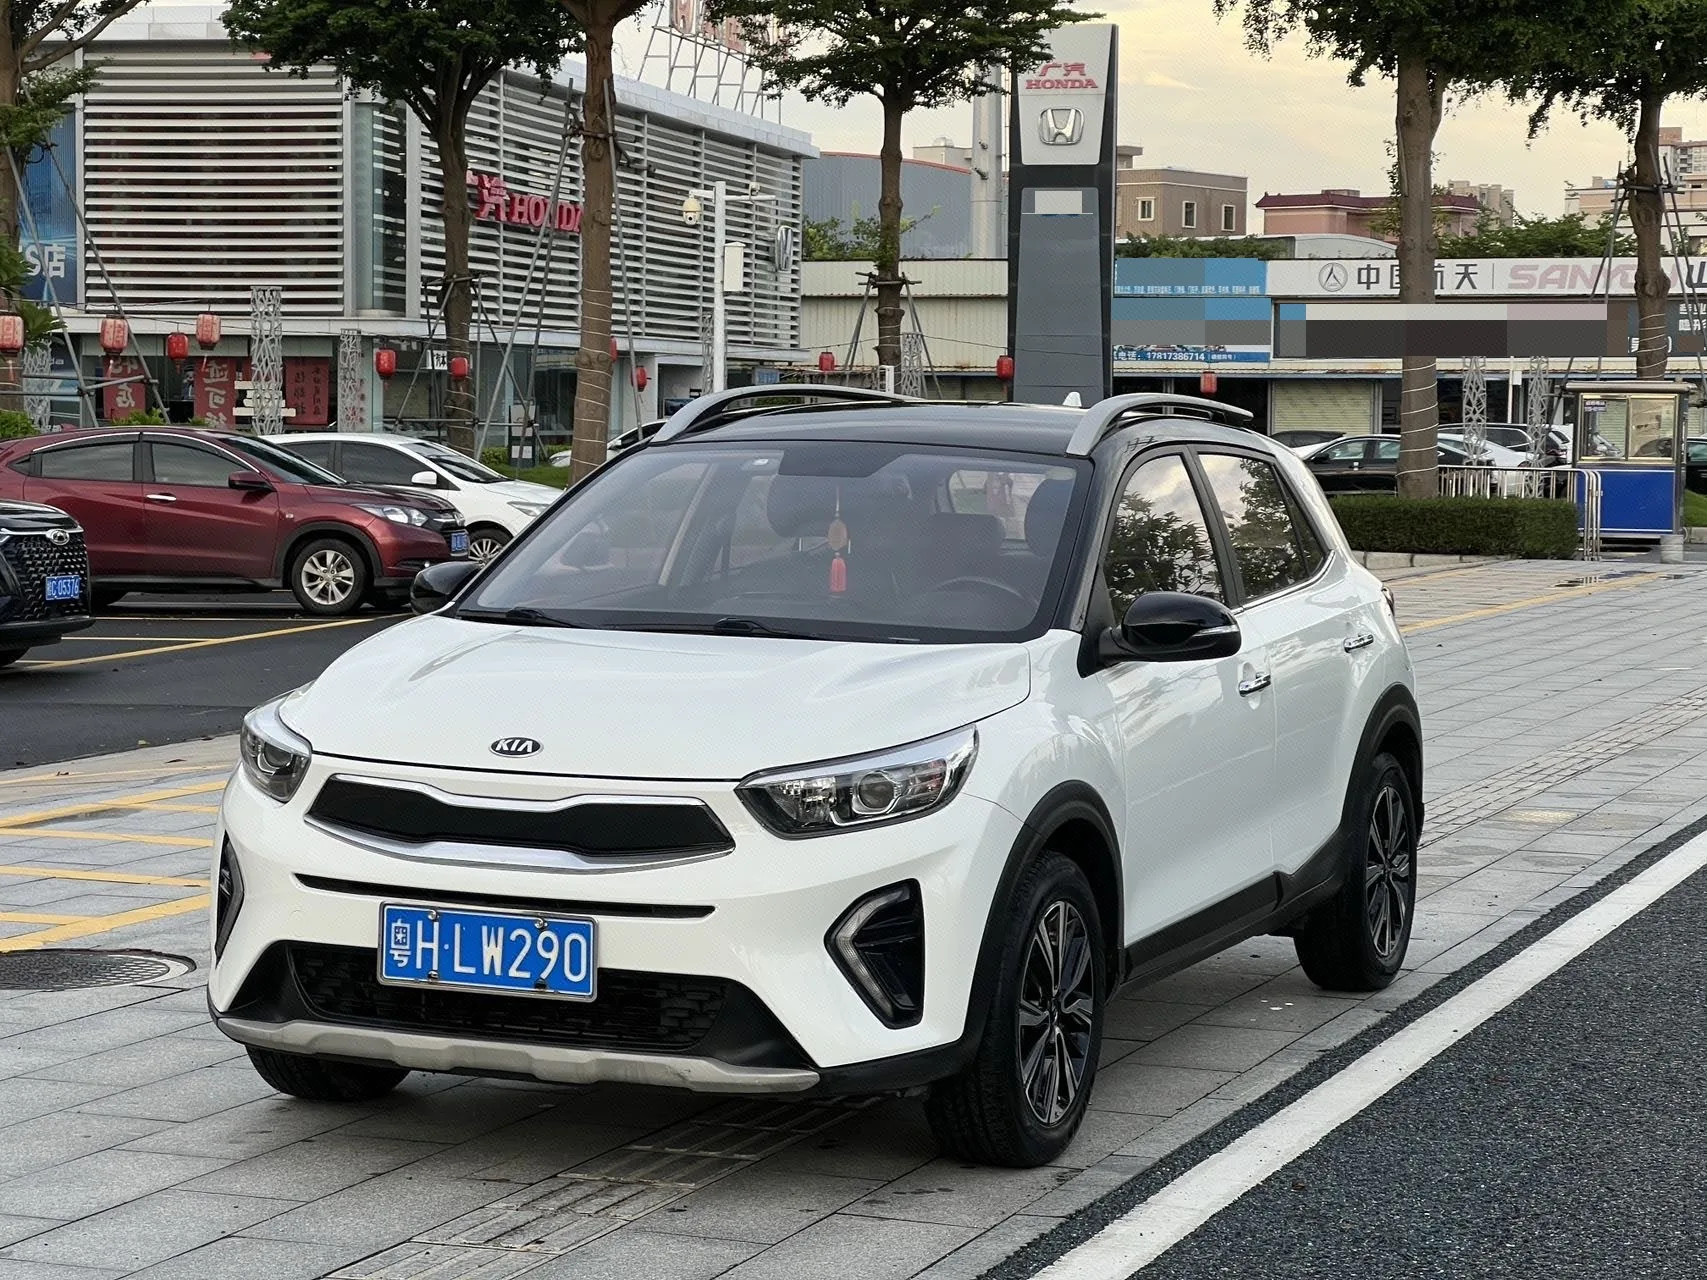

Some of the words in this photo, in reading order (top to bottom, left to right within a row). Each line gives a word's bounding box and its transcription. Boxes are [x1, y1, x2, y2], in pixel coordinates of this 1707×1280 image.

[1039, 63, 1086, 76] 广汽
[1025, 79, 1099, 90] HONDA
[18, 244, 66, 278] S店
[495, 739, 533, 752] KIA
[389, 918, 588, 983] 粤H·LW290
